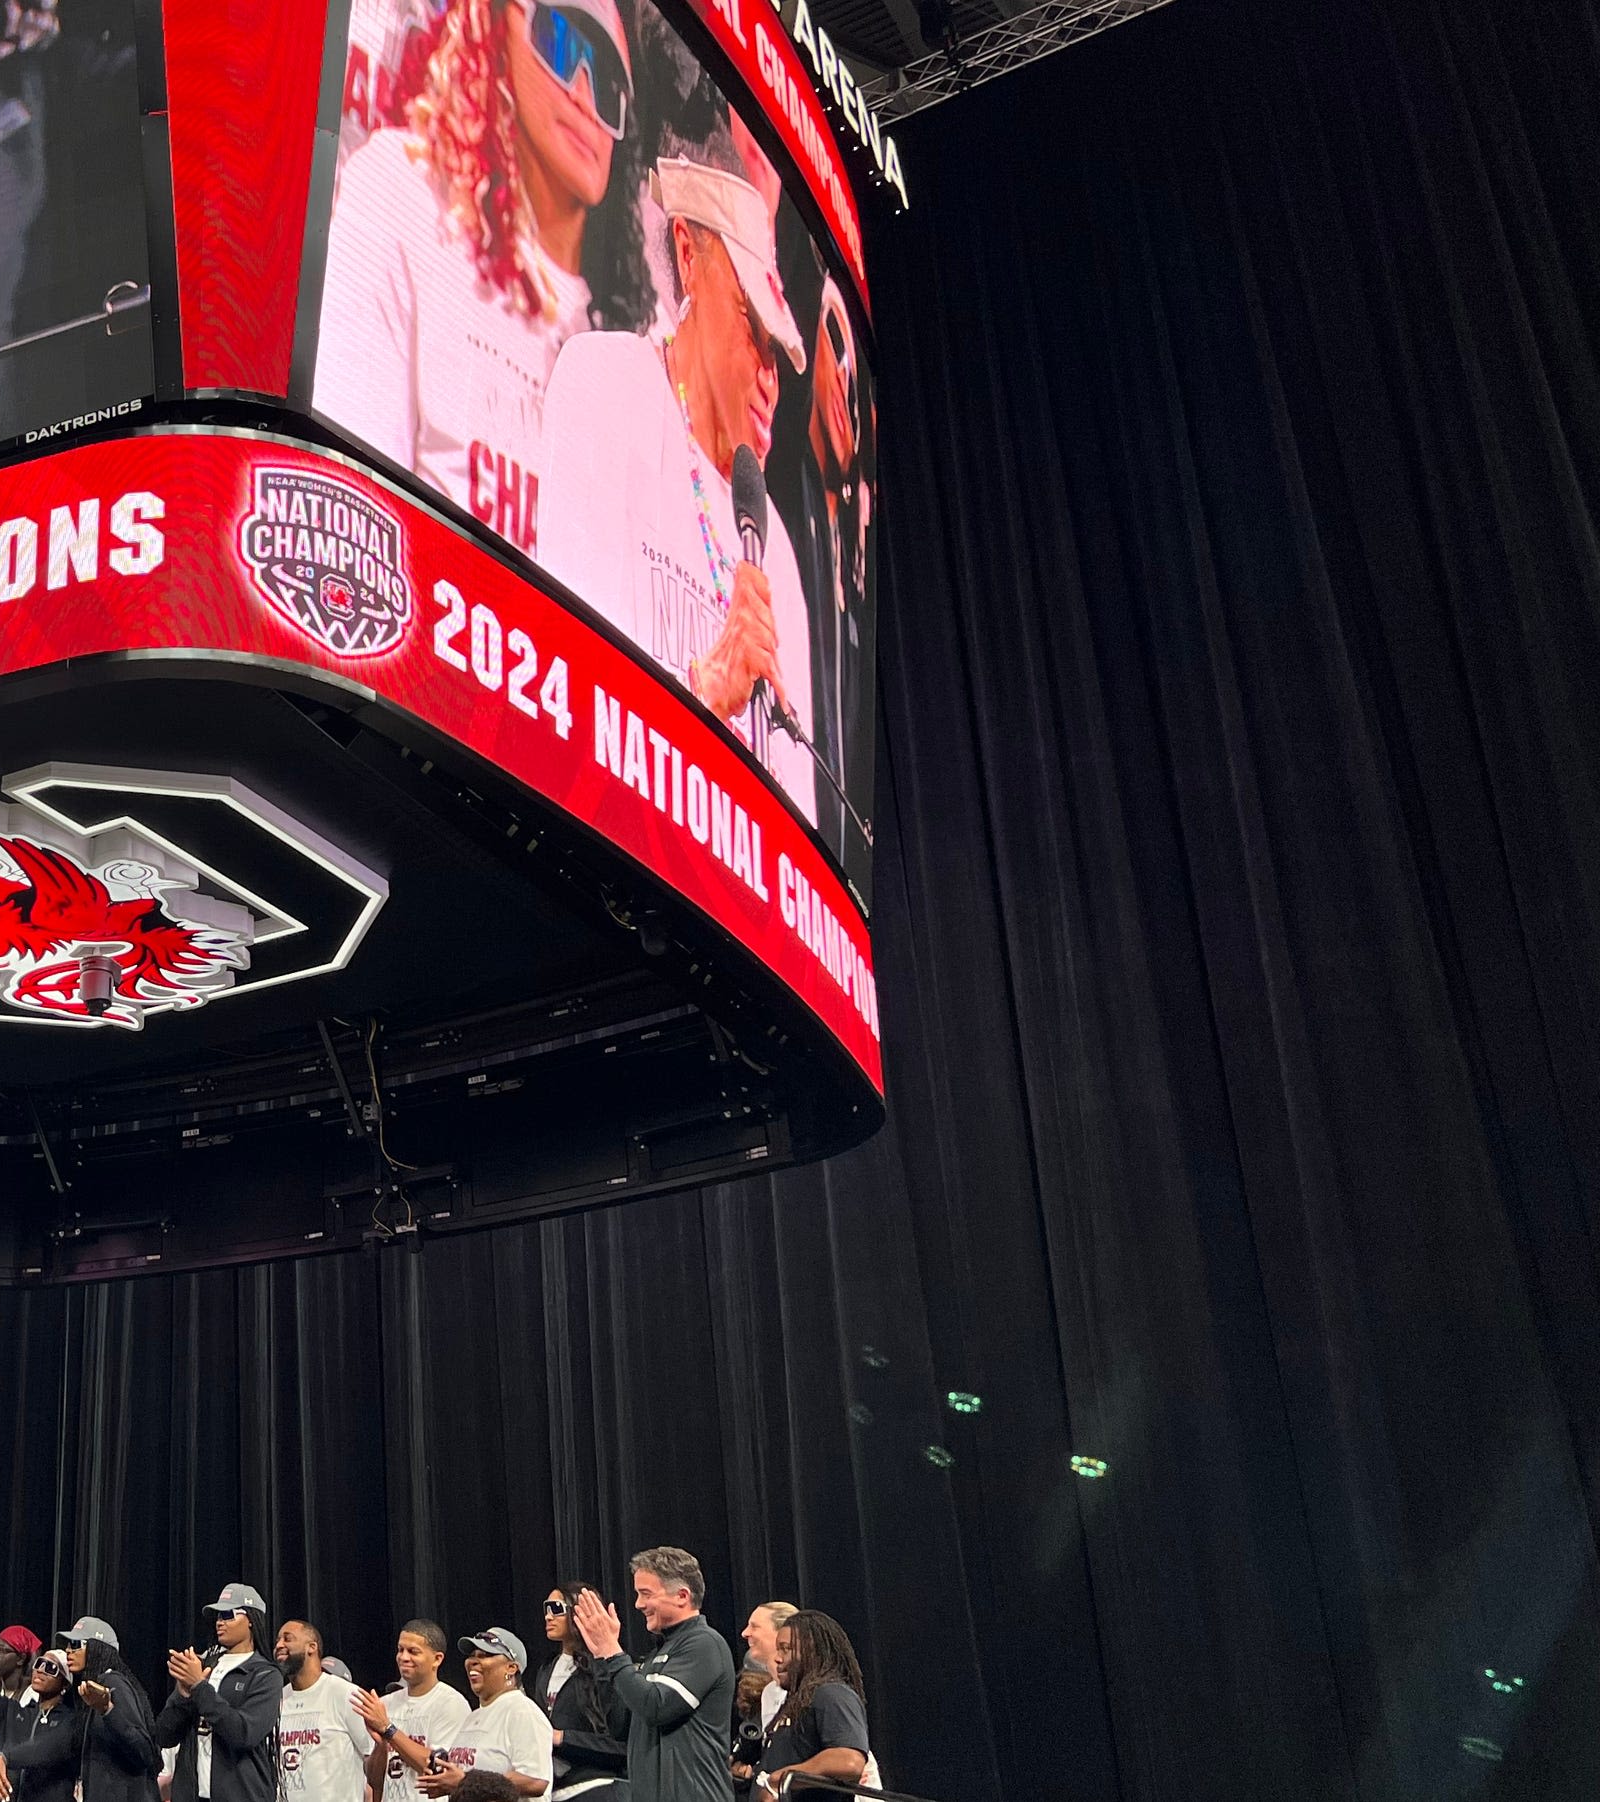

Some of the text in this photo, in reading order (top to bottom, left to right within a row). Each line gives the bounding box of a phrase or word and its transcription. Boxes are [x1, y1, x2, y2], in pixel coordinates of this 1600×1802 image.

[794, 0, 909, 210] ARENA
[25, 398, 142, 444] DAKTRONICS
[254, 525, 405, 612] CHAMPIONS
[267, 488, 394, 571] NATIONAL
[296, 565, 315, 579] 20
[433, 578, 573, 741] 2024
[594, 684, 769, 903] NATIONAL
